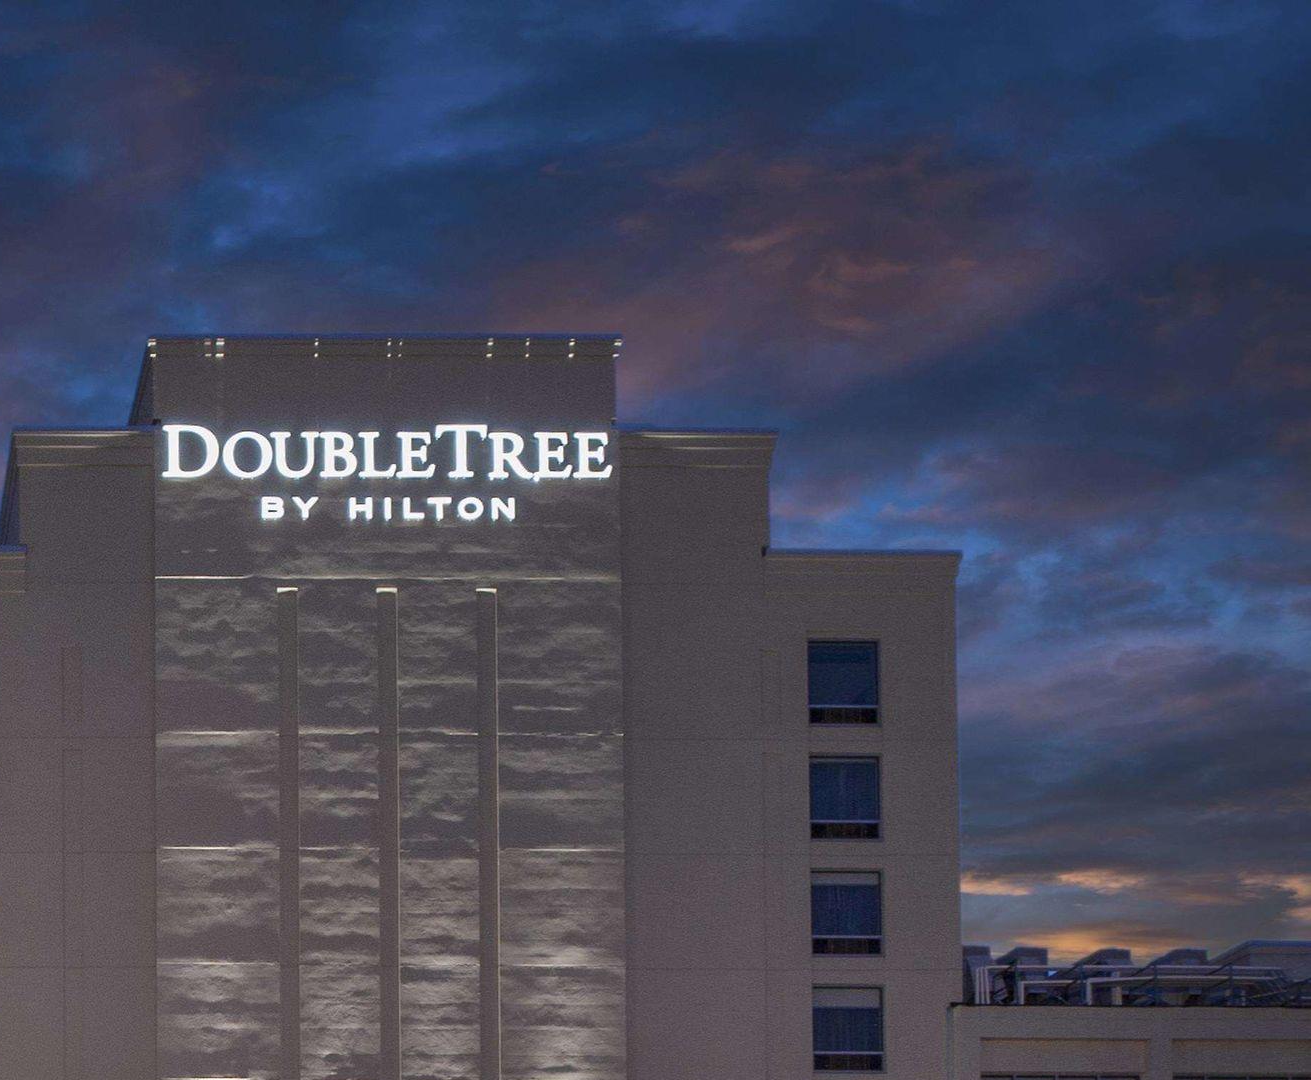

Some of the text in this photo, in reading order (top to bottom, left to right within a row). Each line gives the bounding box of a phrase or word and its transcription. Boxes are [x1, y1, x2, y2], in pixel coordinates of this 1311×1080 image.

[161, 423, 613, 482] DOUBLETREE
[260, 496, 516, 521] BY HILTON
